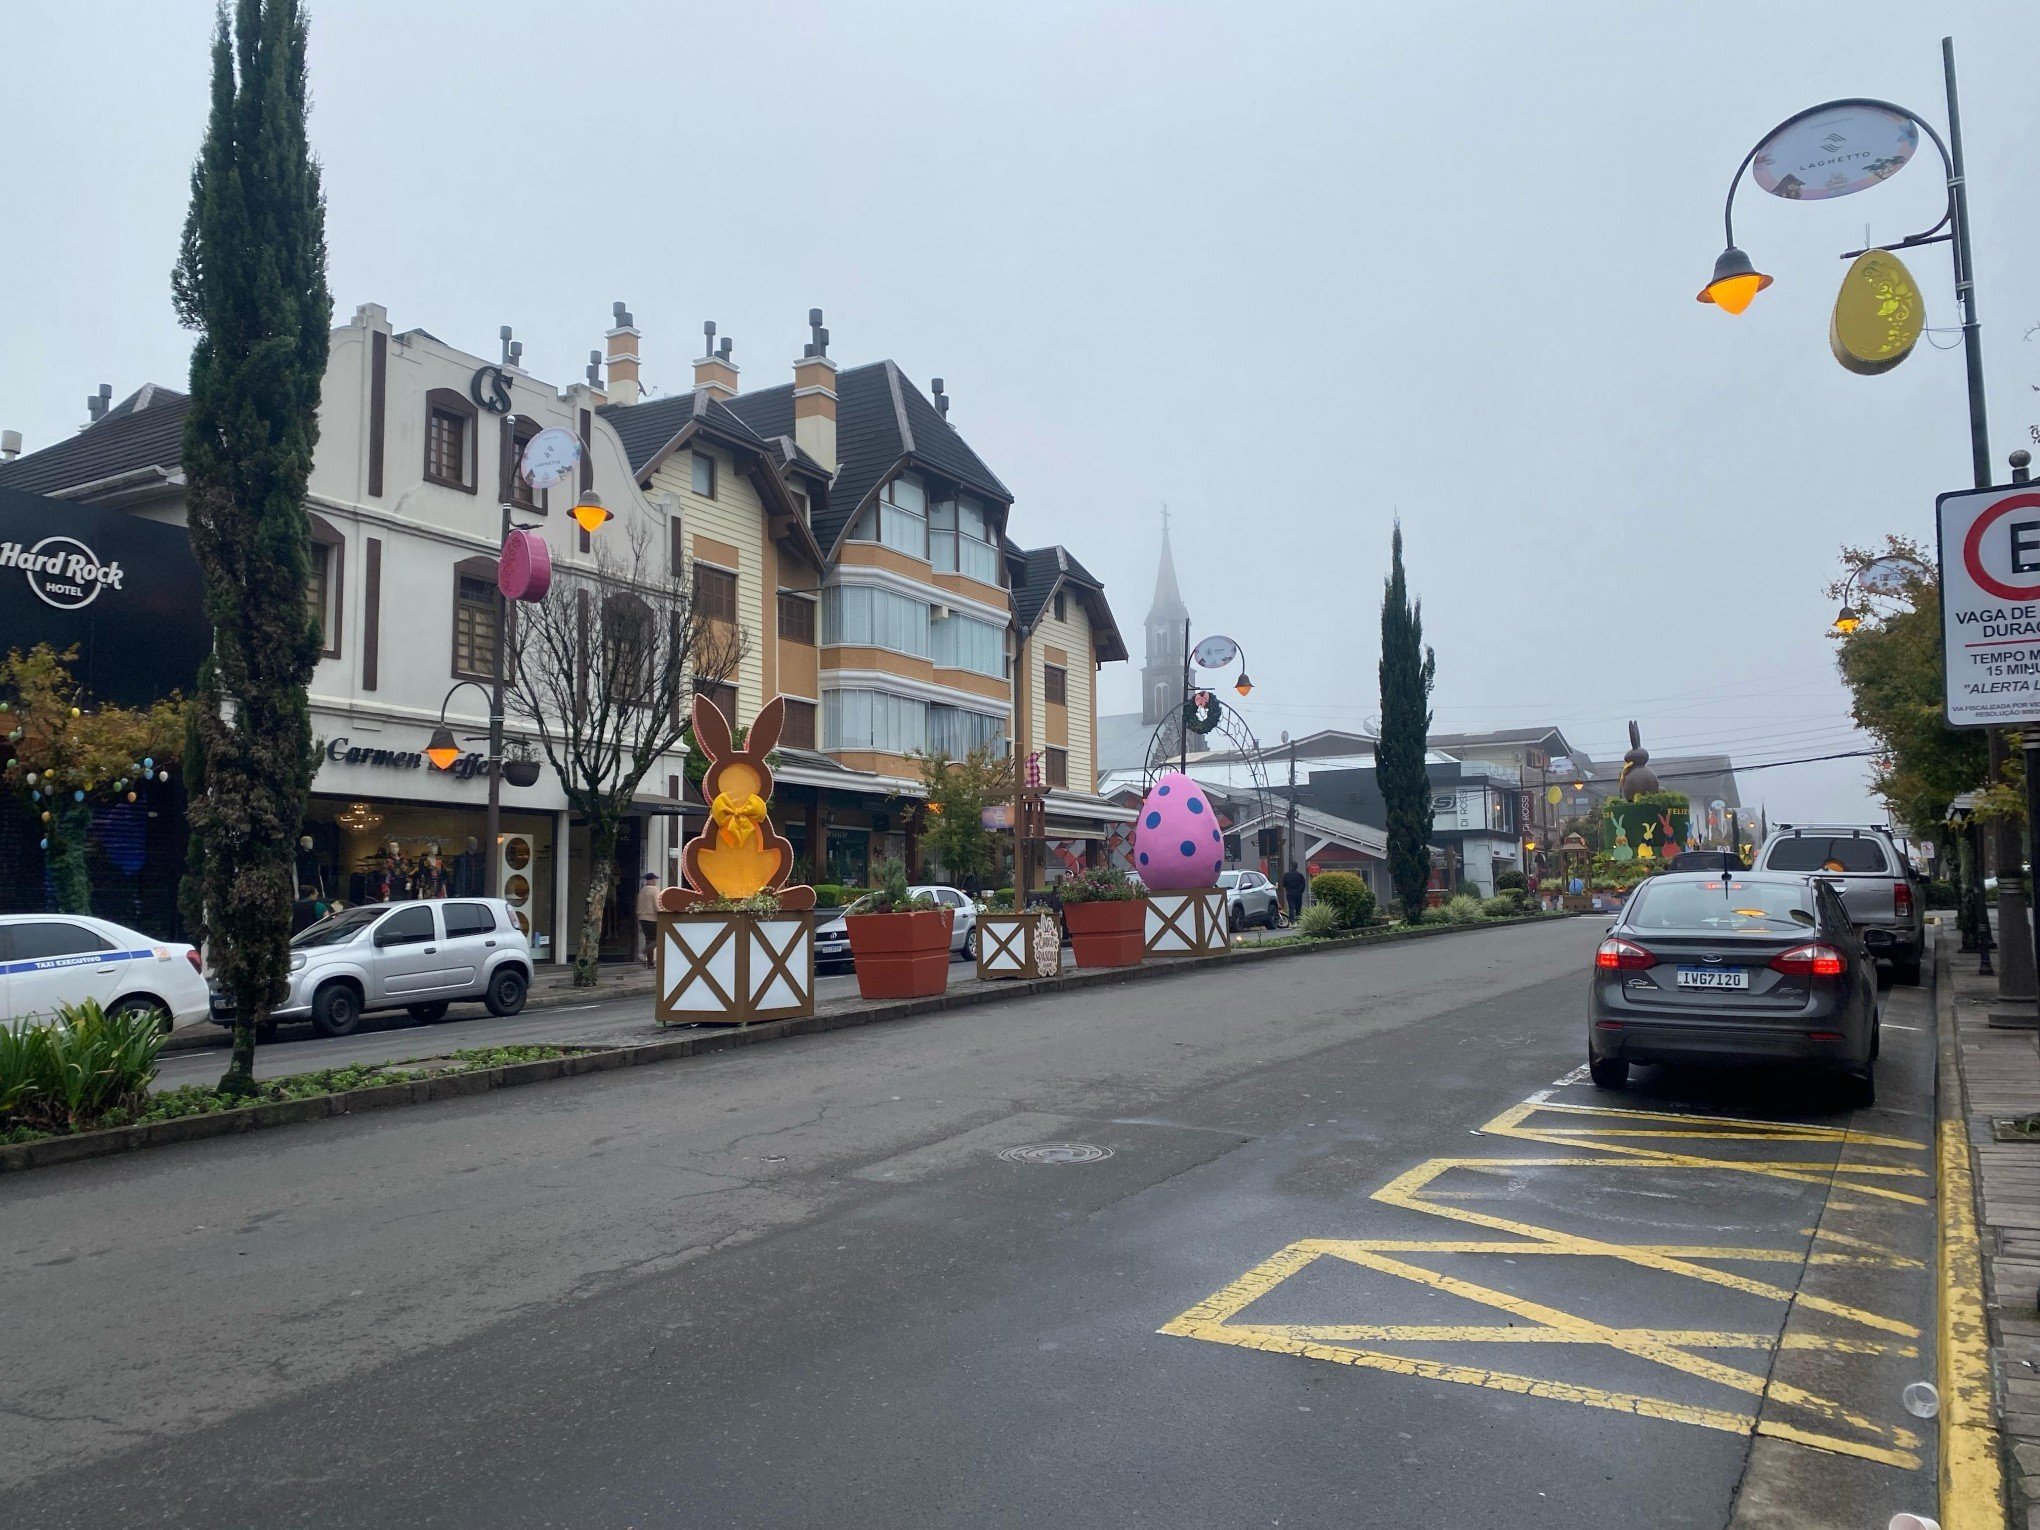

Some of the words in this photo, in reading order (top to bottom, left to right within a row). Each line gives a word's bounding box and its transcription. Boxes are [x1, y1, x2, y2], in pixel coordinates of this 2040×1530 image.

[1800, 151, 1871, 171] LAGHETTO
[0, 542, 66, 575] Hard
[65, 554, 124, 590] Rock
[46, 582, 83, 597] HOTEL
[1956, 609, 2007, 625] VAGA
[2011, 606, 2036, 620] DE
[1970, 650, 2025, 665] TEMPO
[1987, 665, 2003, 677] 15
[327, 737, 422, 769] Carmen
[35, 961, 56, 969] TAXI
[57, 956, 101, 967] EXECUTIVO
